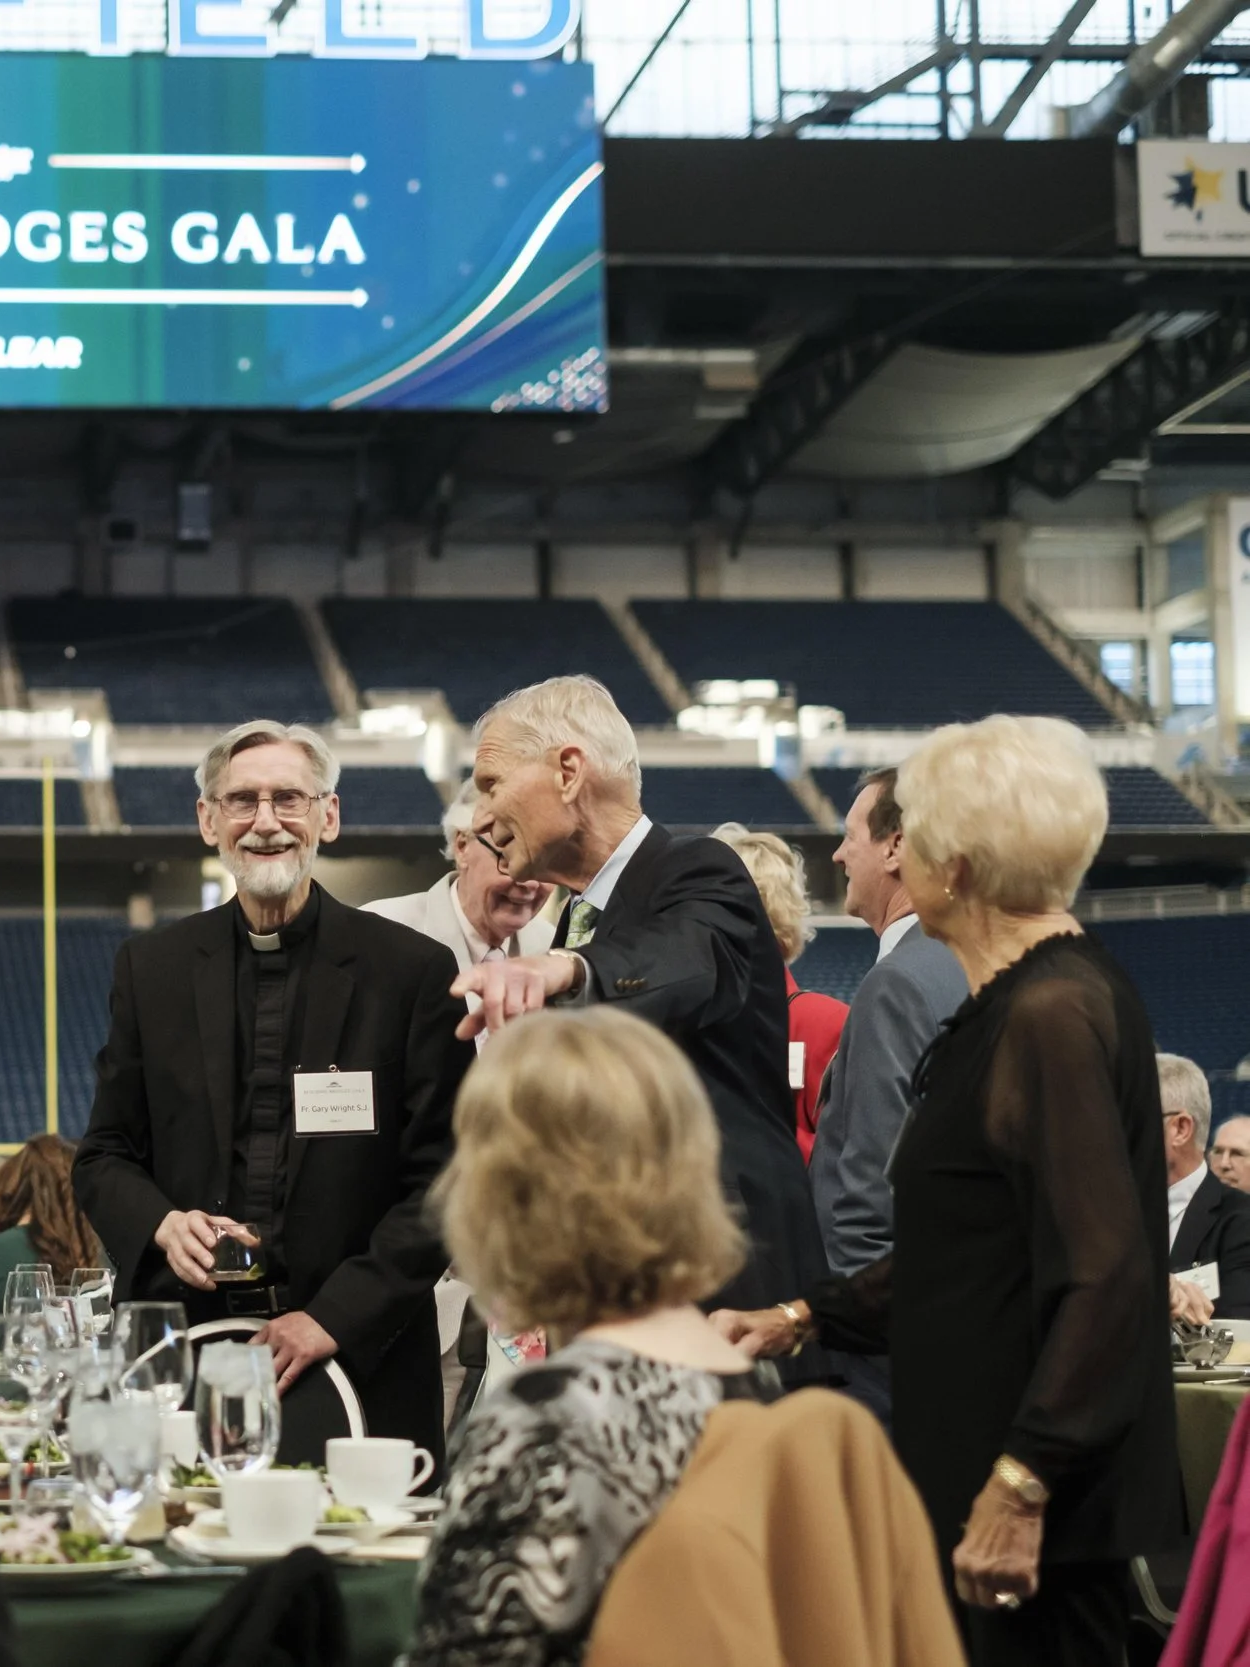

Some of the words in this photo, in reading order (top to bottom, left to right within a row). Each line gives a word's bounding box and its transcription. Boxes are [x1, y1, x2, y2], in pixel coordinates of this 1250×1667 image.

[171, 212, 366, 264] GALA
[312, 1105, 329, 1114] Gary
[330, 1104, 355, 1113] Wright
